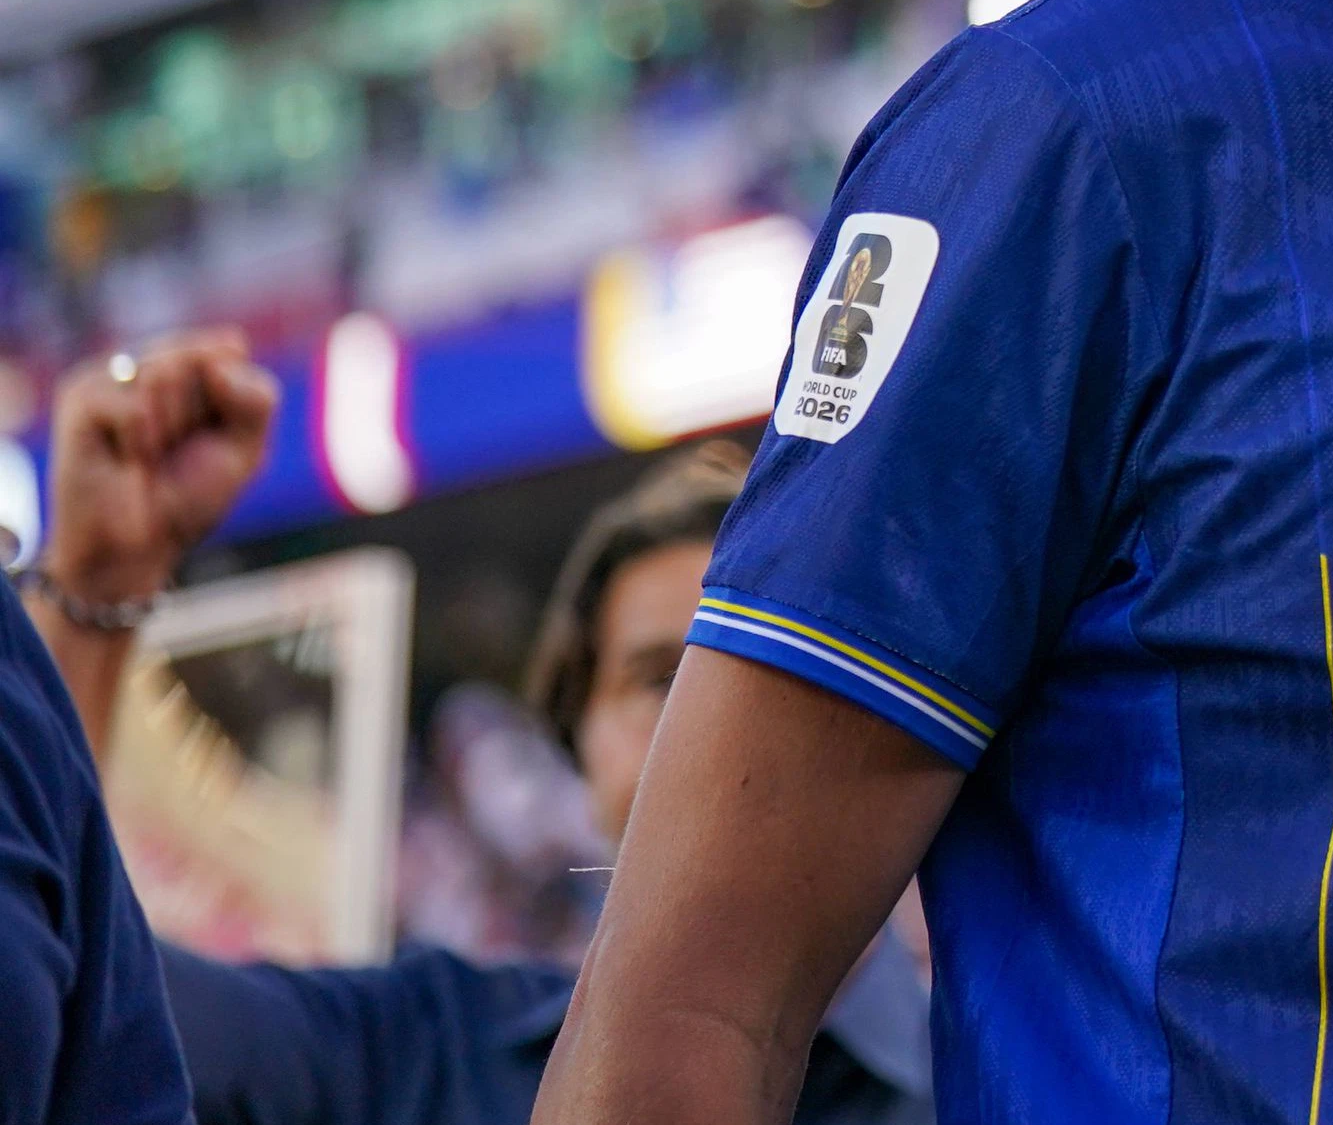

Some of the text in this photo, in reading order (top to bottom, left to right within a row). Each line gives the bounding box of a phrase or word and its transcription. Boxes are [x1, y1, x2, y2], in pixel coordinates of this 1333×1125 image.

[820, 346, 847, 366] FIFA
[833, 386, 858, 402] CUP
[794, 396, 851, 425] 2026
